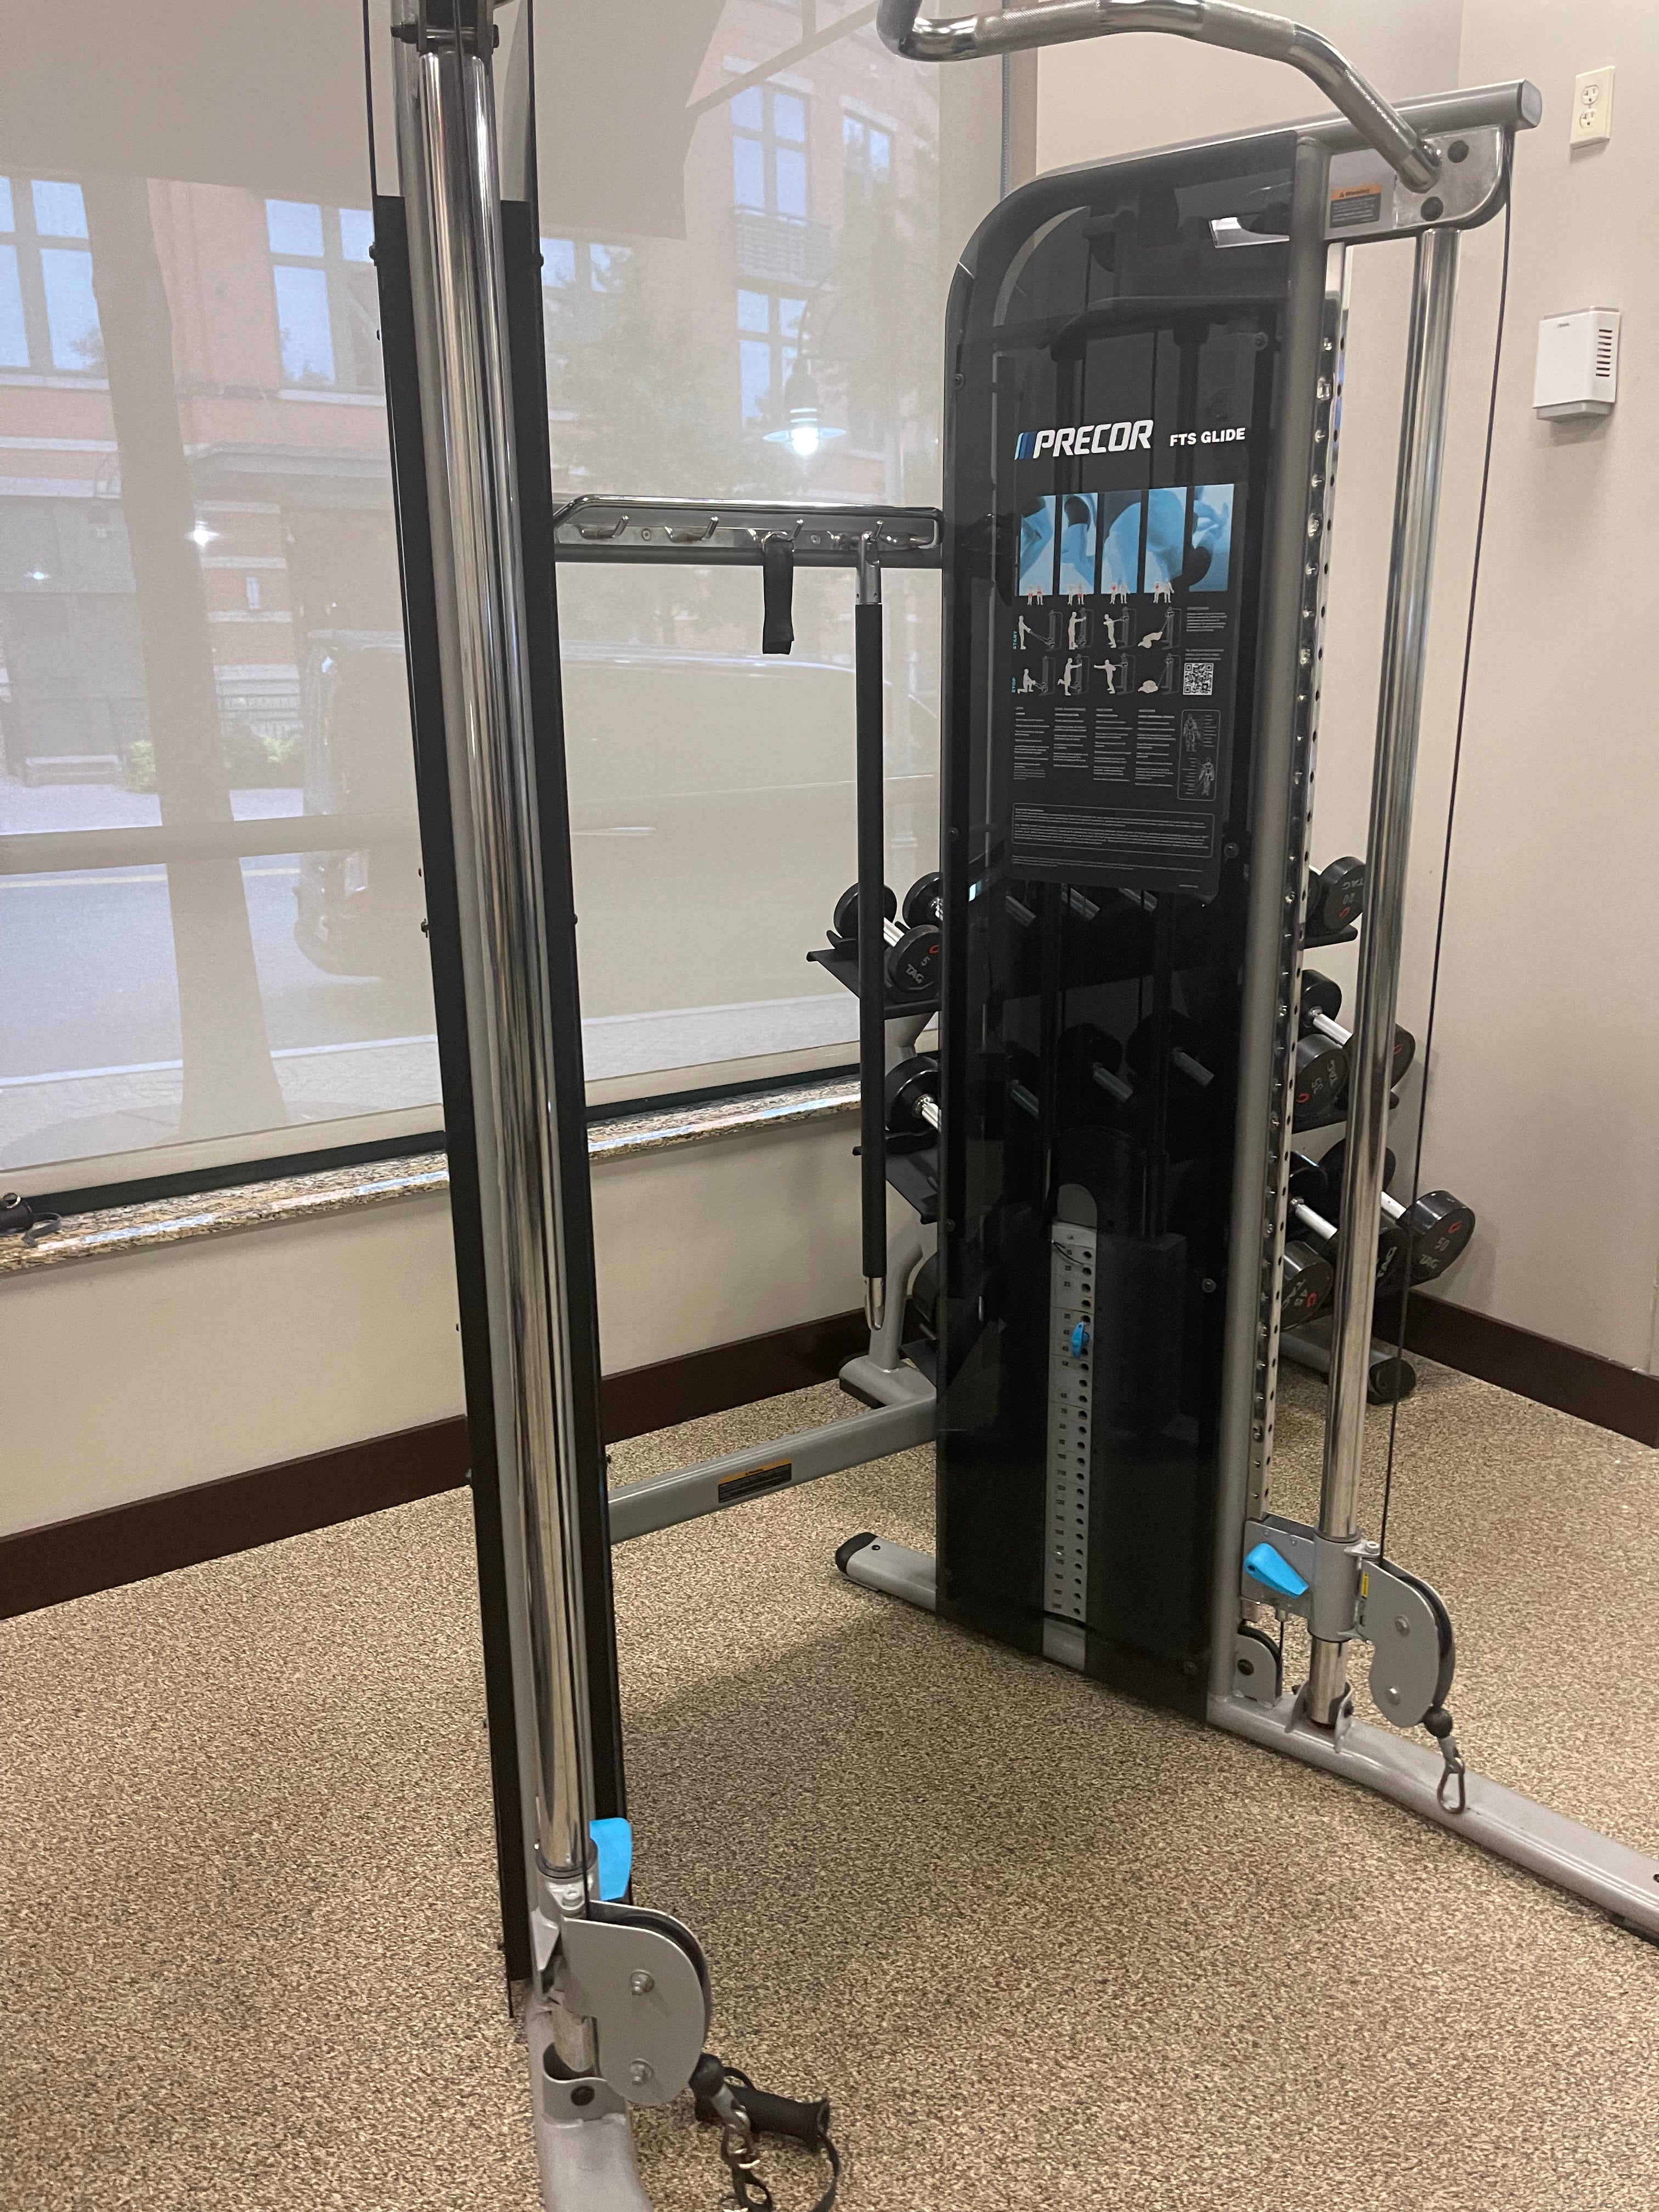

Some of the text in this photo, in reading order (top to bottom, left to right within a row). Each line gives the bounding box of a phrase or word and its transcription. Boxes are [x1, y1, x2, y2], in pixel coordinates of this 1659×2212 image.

[1033, 419, 1154, 459] PRECOR
[1170, 427, 1246, 447] FTS GLIDE
[921, 956, 931, 966] 5
[906, 963, 924, 984] TAG
[1434, 1237, 1450, 1251] 50
[1419, 1254, 1440, 1269] TAG
